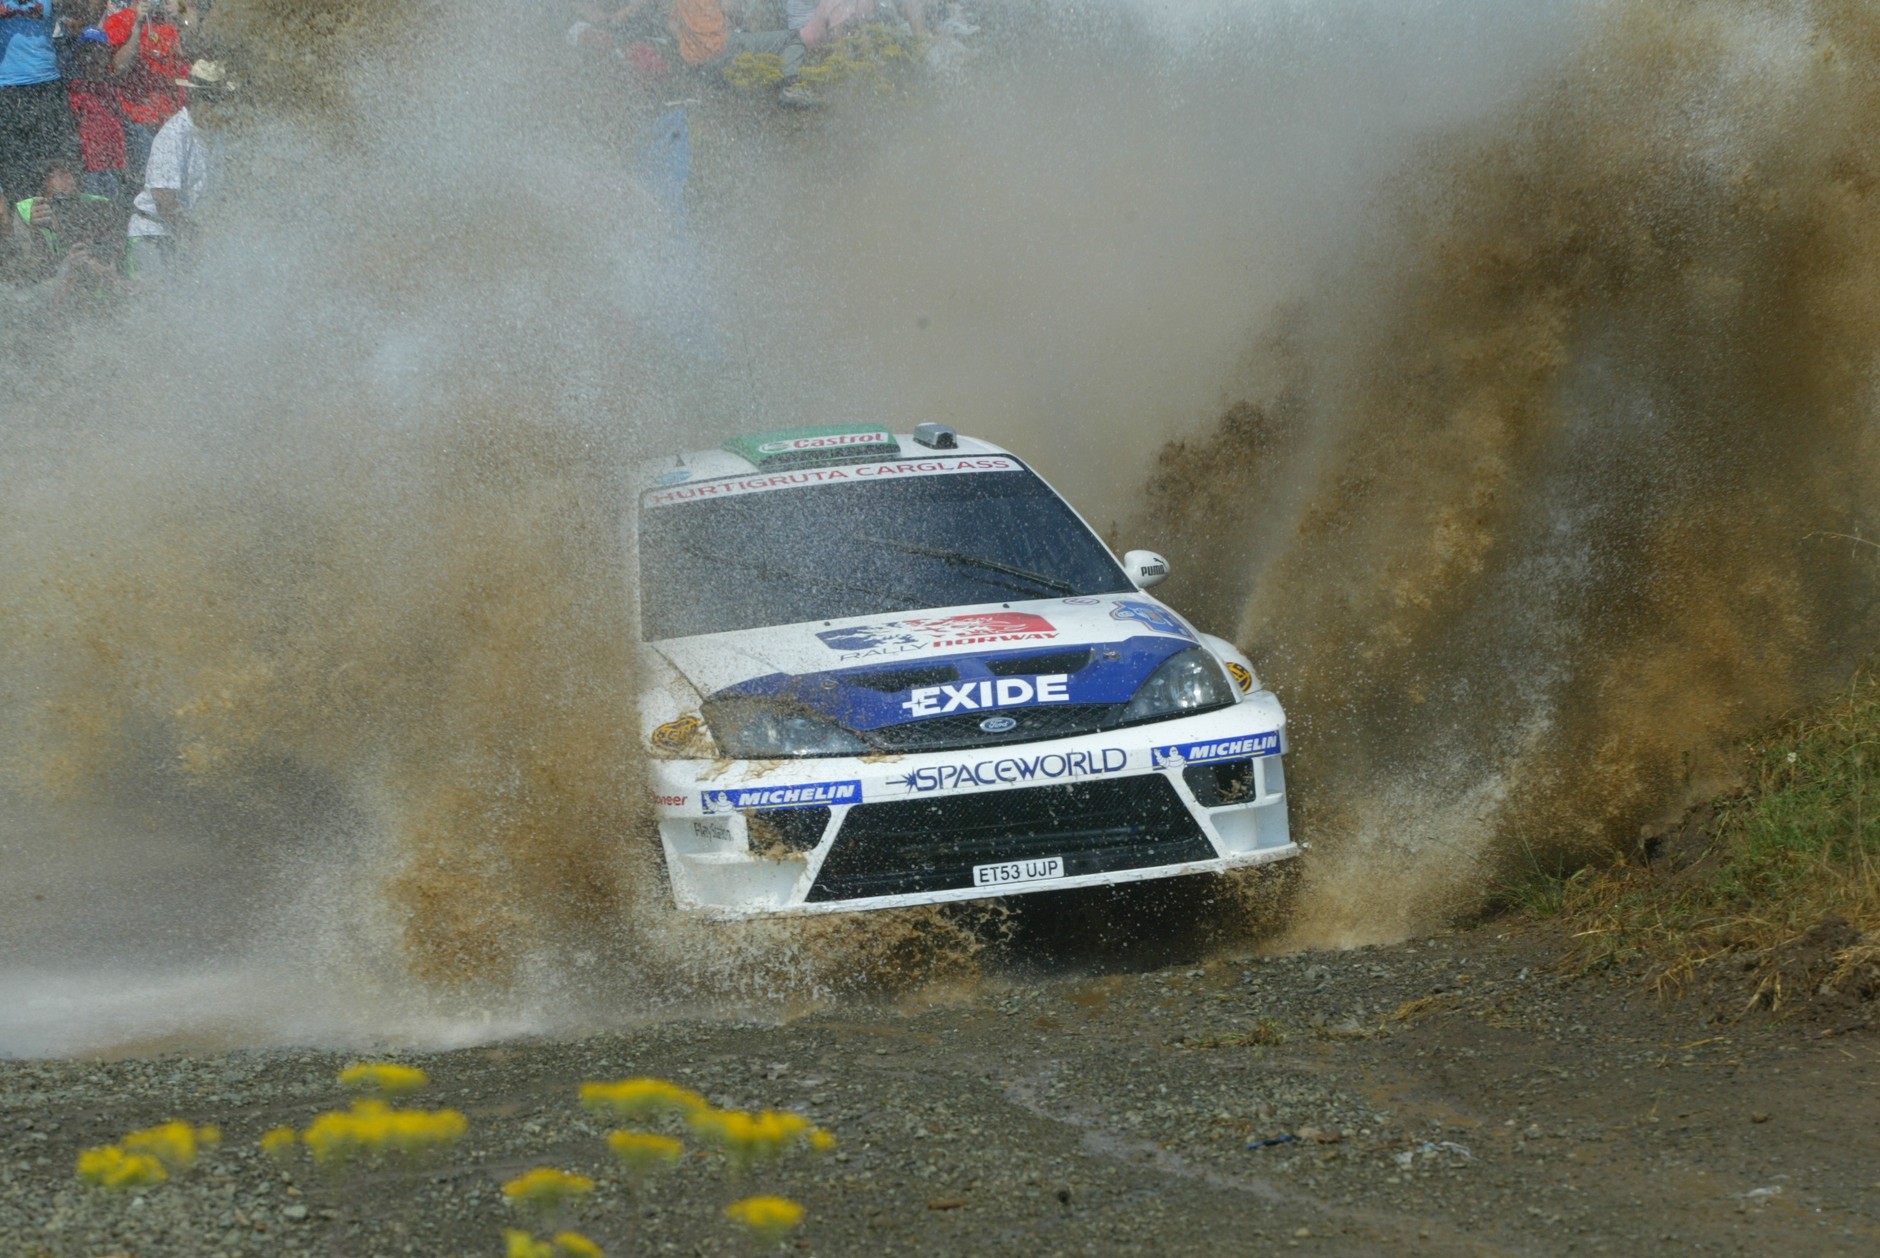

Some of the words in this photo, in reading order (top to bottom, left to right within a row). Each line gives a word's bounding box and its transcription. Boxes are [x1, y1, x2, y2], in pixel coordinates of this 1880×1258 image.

[794, 433, 882, 448] Castrol
[655, 471, 849, 503] HURTIGRUTA
[855, 460, 1009, 480] CARGLASS
[1141, 565, 1165, 576] PUMA
[840, 642, 929, 661] RALLY
[902, 673, 1070, 717] EXIDE
[1188, 735, 1278, 760] MICHELIN
[915, 747, 1127, 792] SPACEWORLD
[737, 784, 855, 806] MICHELIN
[978, 864, 1021, 884] ET53
[1026, 859, 1059, 878] UJP
